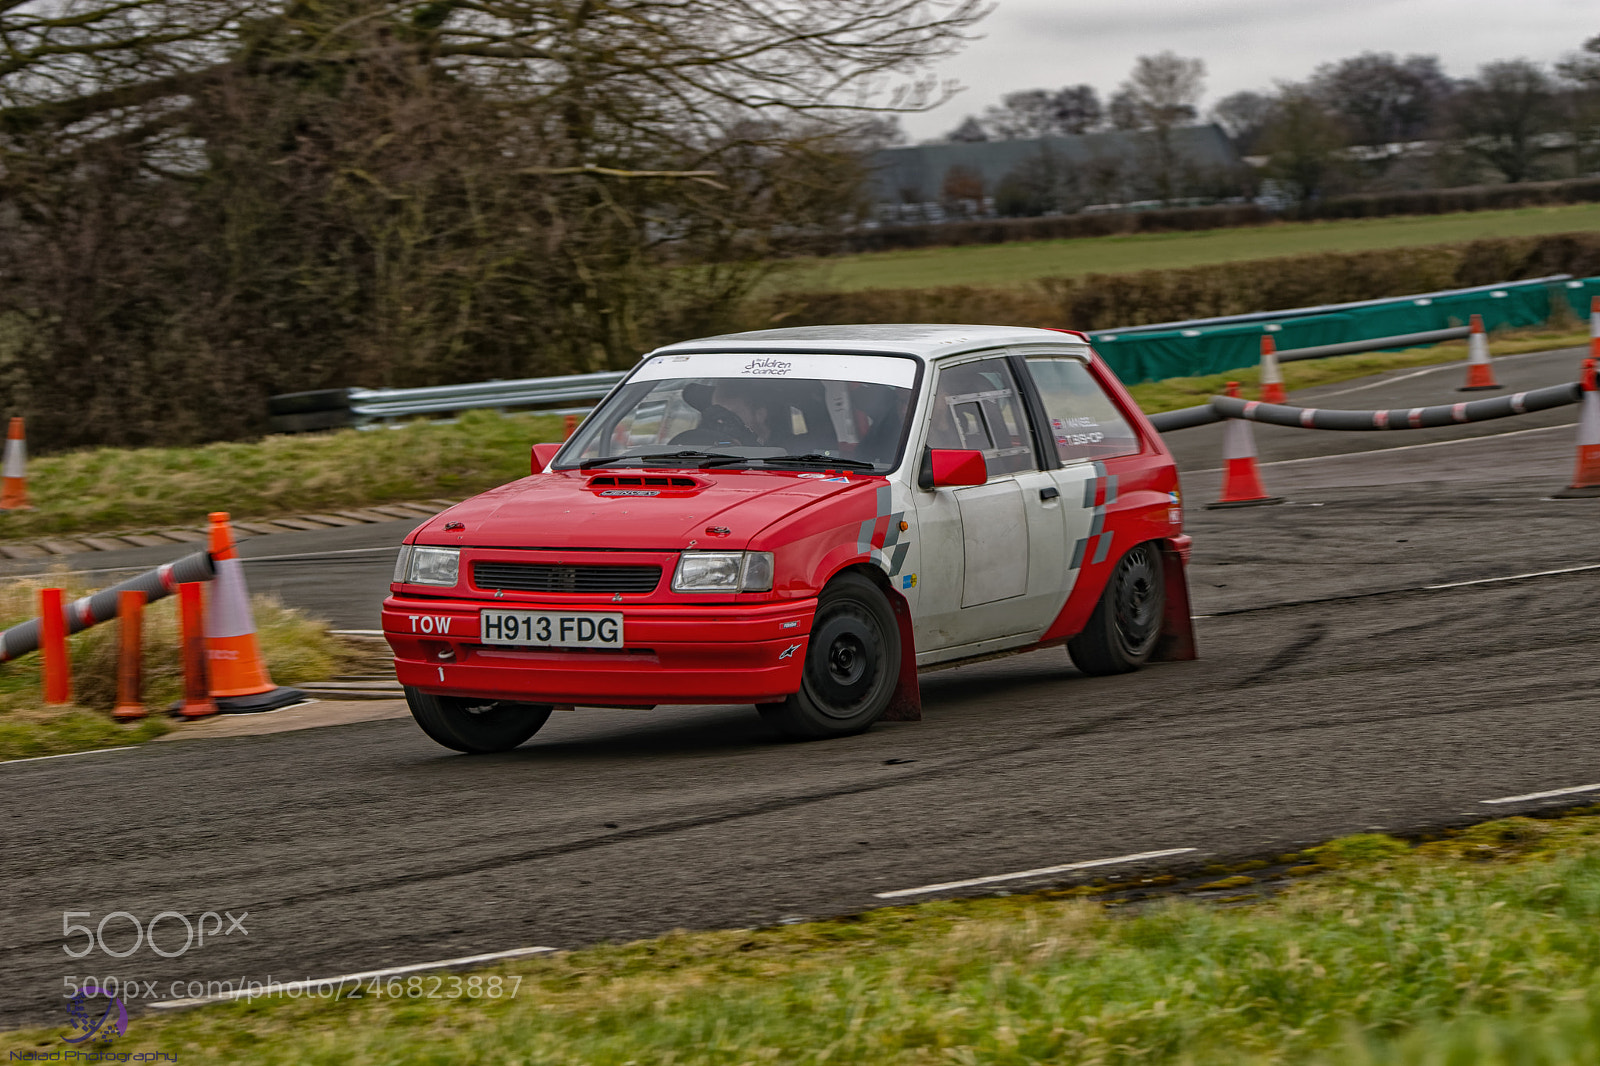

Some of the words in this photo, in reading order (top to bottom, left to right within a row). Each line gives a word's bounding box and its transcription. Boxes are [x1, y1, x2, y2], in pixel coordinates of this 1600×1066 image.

[752, 368, 792, 376] cancer
[408, 615, 452, 635] TOW
[484, 614, 552, 642] H913
[559, 616, 619, 643] FDG
